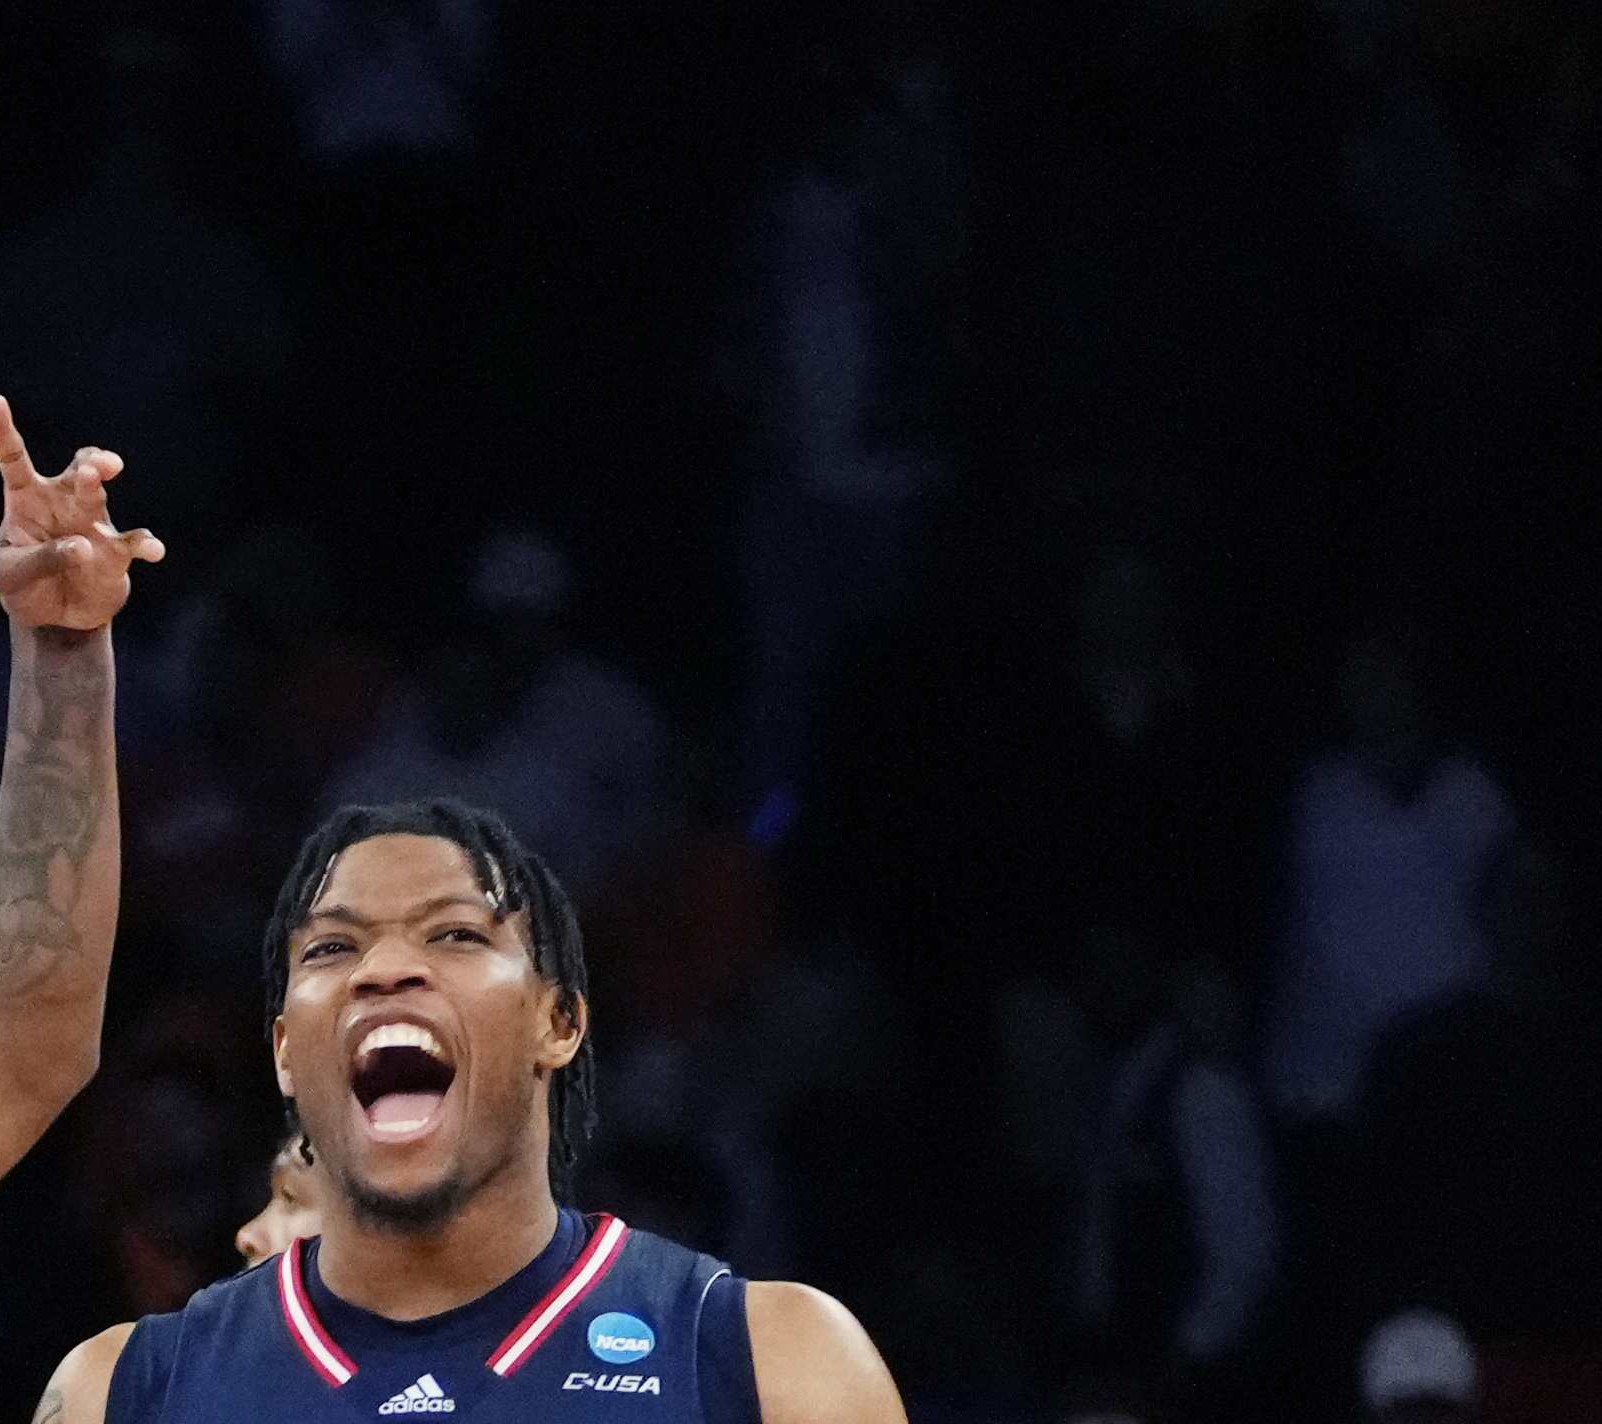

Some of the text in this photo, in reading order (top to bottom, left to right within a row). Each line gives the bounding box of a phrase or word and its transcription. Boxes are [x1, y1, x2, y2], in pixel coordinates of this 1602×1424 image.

[595, 1334, 650, 1352] NCAA
[562, 1372, 661, 1396] C-USA
[378, 1396, 456, 1415] adidas
